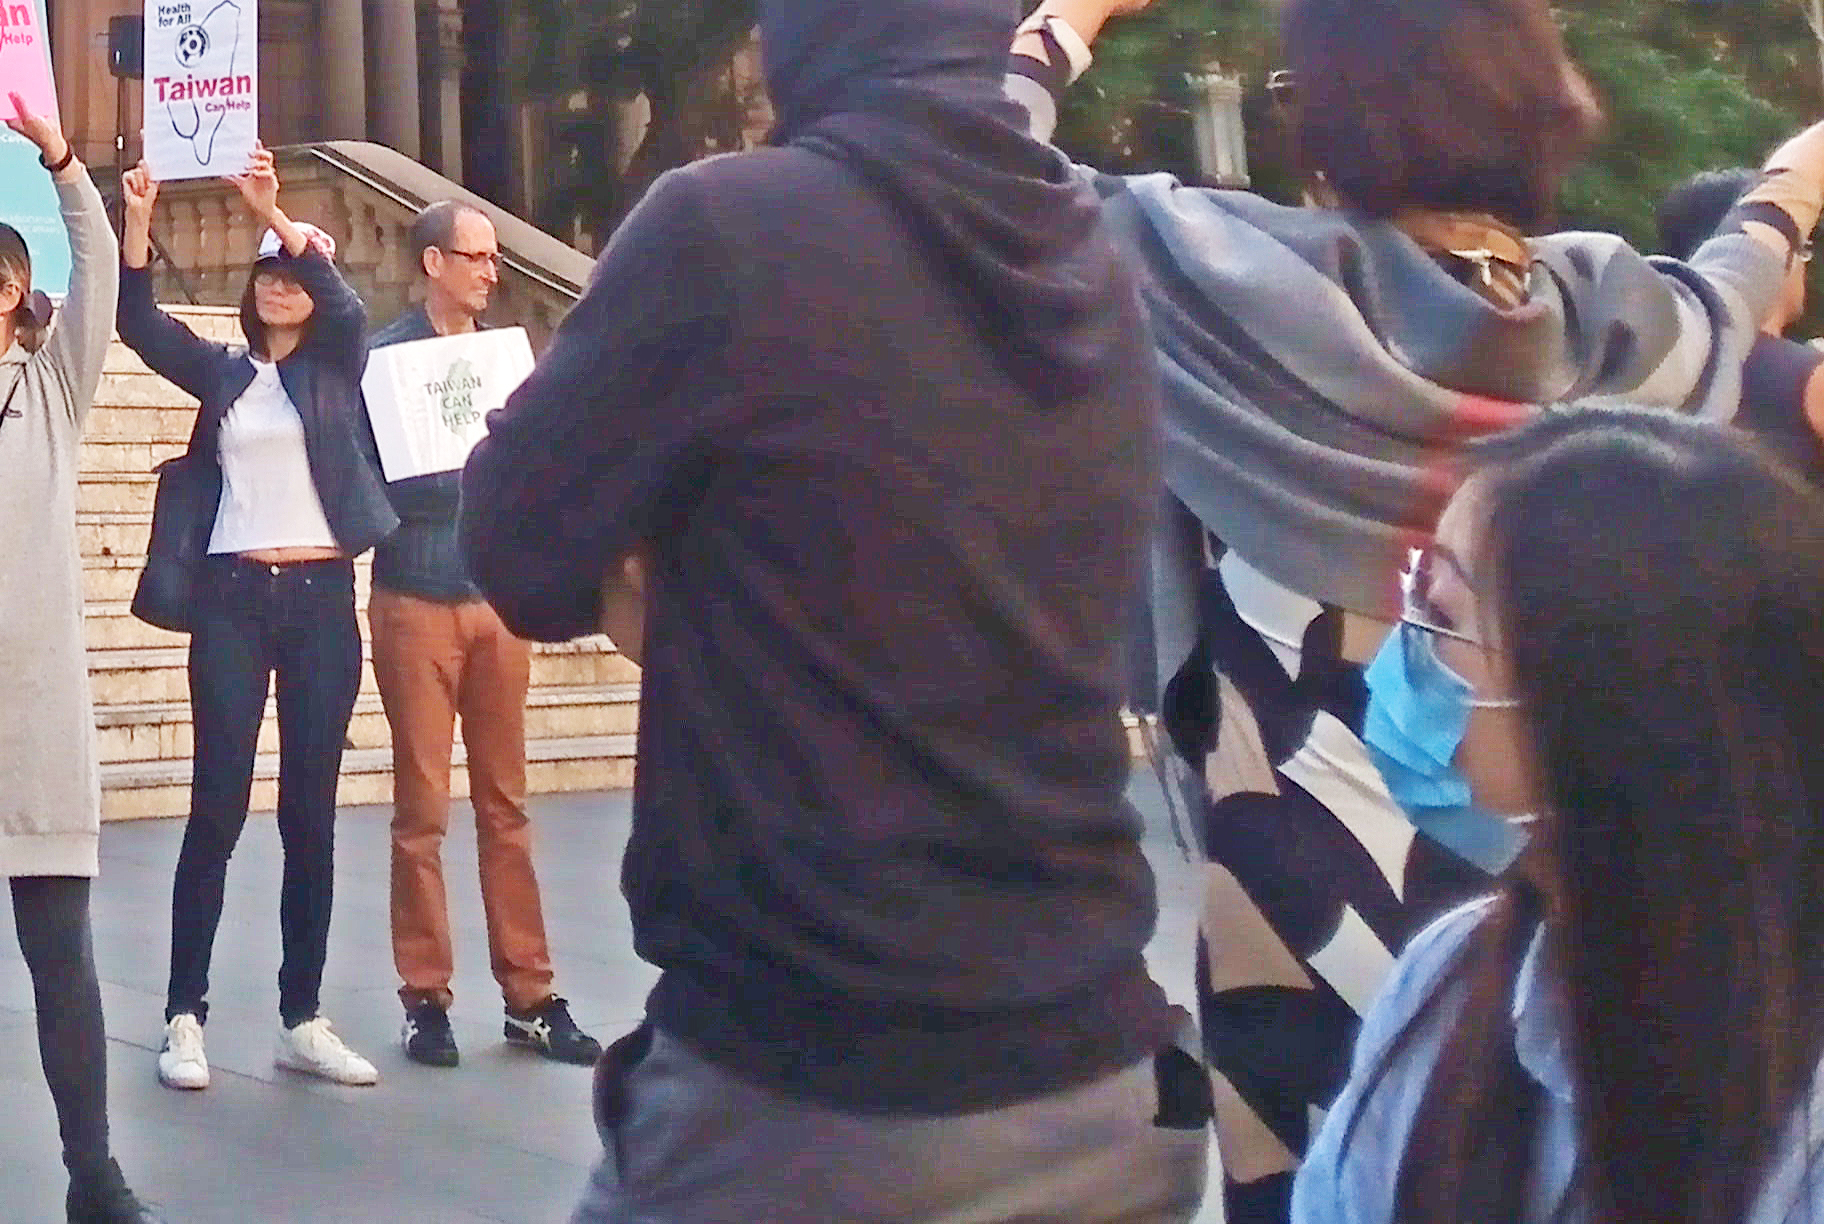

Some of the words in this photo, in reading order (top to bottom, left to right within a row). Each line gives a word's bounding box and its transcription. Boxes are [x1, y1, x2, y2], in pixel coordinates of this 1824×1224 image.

[158, 3, 191, 17] Health
[158, 16, 174, 28] for
[177, 14, 191, 26] All
[4, 33, 34, 47] Help
[153, 74, 252, 103] Taiwan
[205, 102, 225, 113] Can
[227, 100, 252, 112] Help
[424, 376, 482, 395] TAIWAN
[442, 393, 472, 409] CAN
[442, 411, 481, 427] HELP
